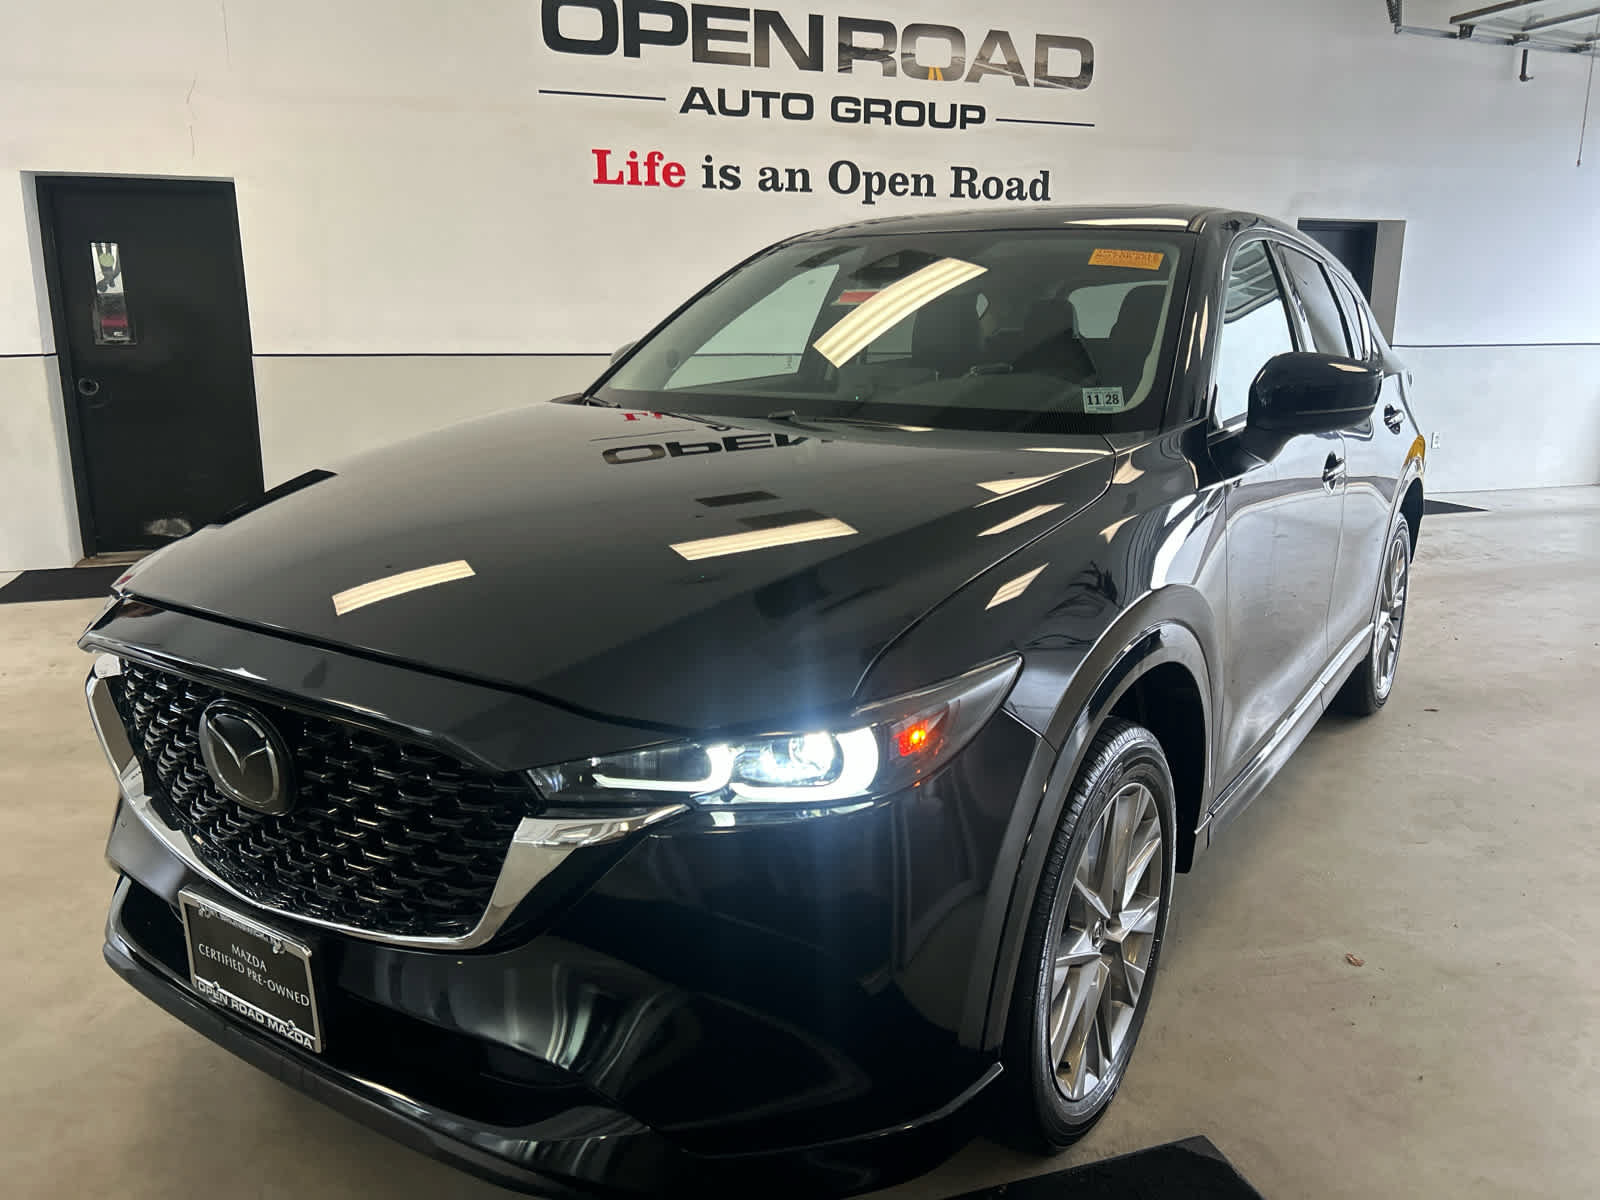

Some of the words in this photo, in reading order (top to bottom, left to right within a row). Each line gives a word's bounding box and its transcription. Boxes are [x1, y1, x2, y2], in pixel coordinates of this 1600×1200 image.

[541, 0, 824, 73] OPEN
[838, 16, 1094, 90] ROAD
[680, 87, 814, 121] AUTO
[831, 96, 986, 129] GROUP
[592, 149, 686, 189] Life
[702, 155, 741, 190] is
[759, 167, 812, 192] an
[828, 161, 936, 204] Open
[950, 167, 1051, 201] Road
[1087, 394, 1101, 406] 11
[1105, 393, 1119, 405] 28
[198, 943, 245, 974] CERTIFIED
[247, 967, 310, 1006] PRE-OWNED
[231, 943, 267, 973] MAZDA
[198, 981, 228, 1005] OPEN
[231, 998, 265, 1024] ROAD
[267, 1018, 313, 1049] MAZDA
